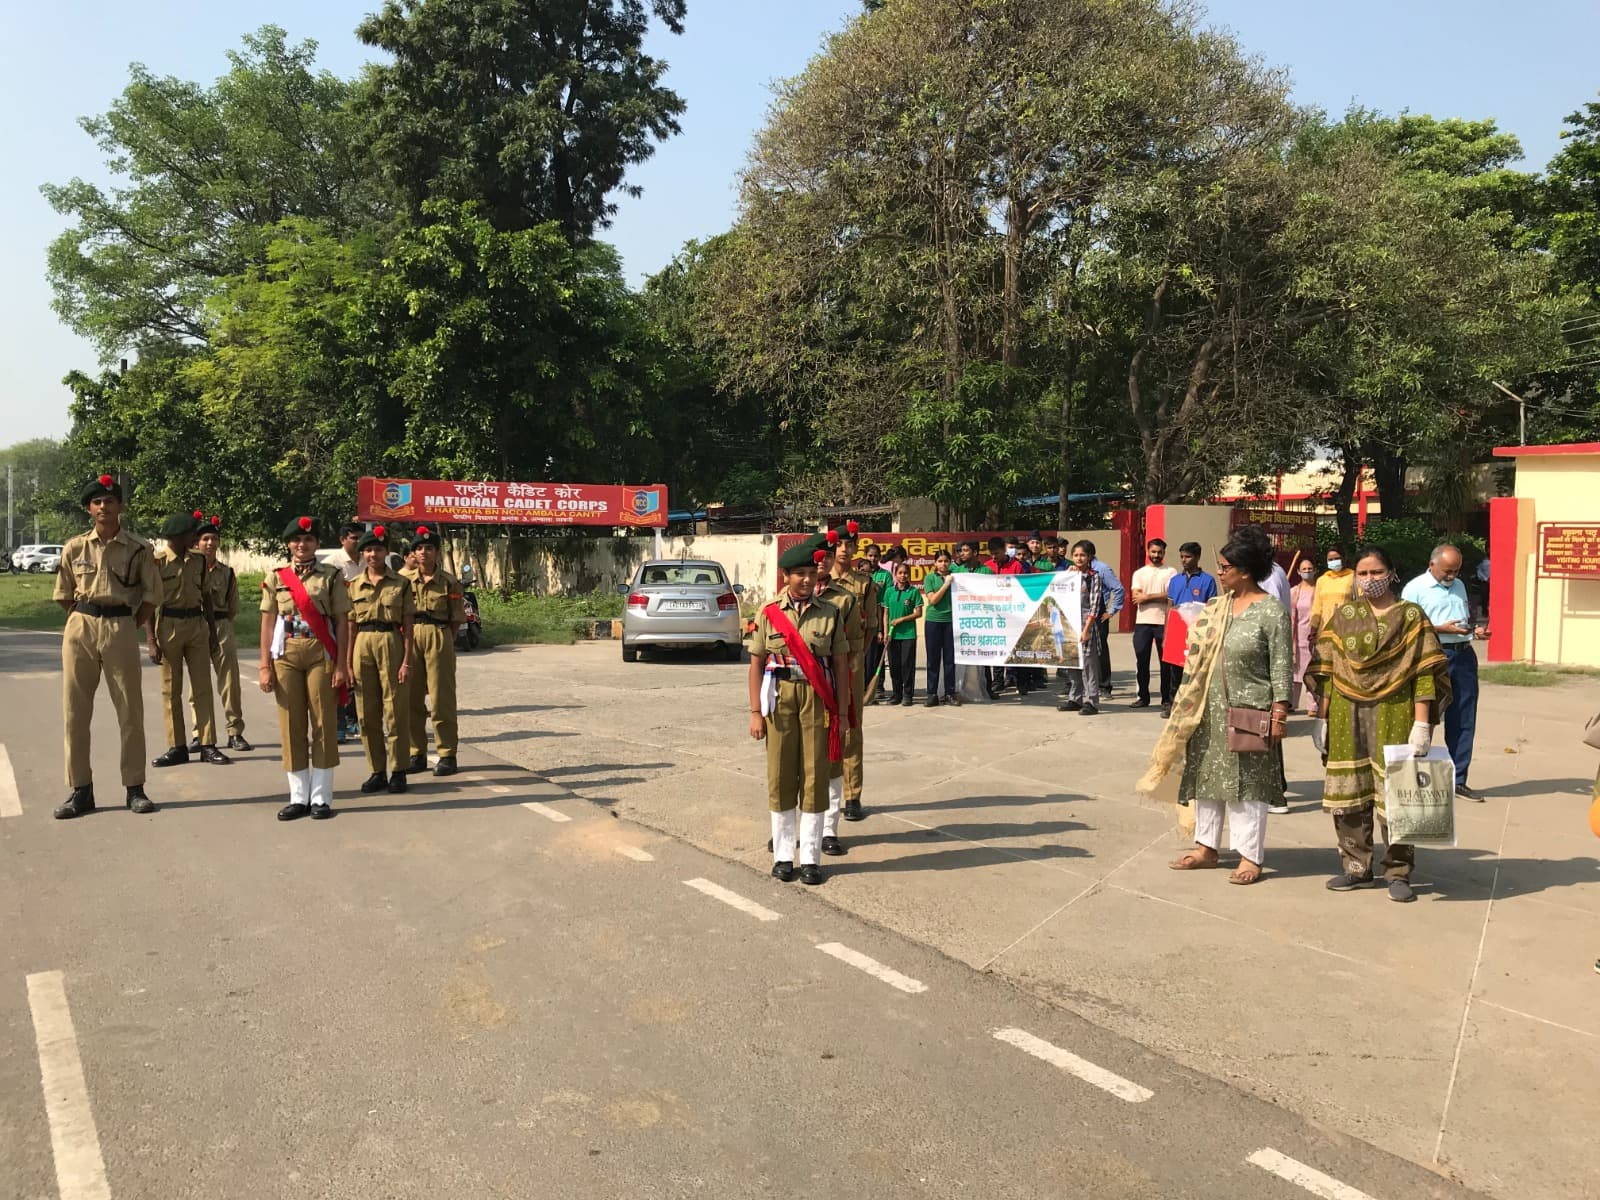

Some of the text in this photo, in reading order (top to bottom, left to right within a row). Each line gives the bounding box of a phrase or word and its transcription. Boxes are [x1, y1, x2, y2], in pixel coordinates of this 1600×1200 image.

[454, 482, 499, 497] राष्ट्रीय
[554, 484, 583, 498] कोर
[424, 495, 608, 511] NATIONAL CADET CORPS
[434, 507, 482, 515] HARYANA
[959, 614, 1006, 630] स्वच्छता के
[960, 632, 1007, 647] लिए श्रमदान
[1397, 789, 1450, 799] BHAGWATI
